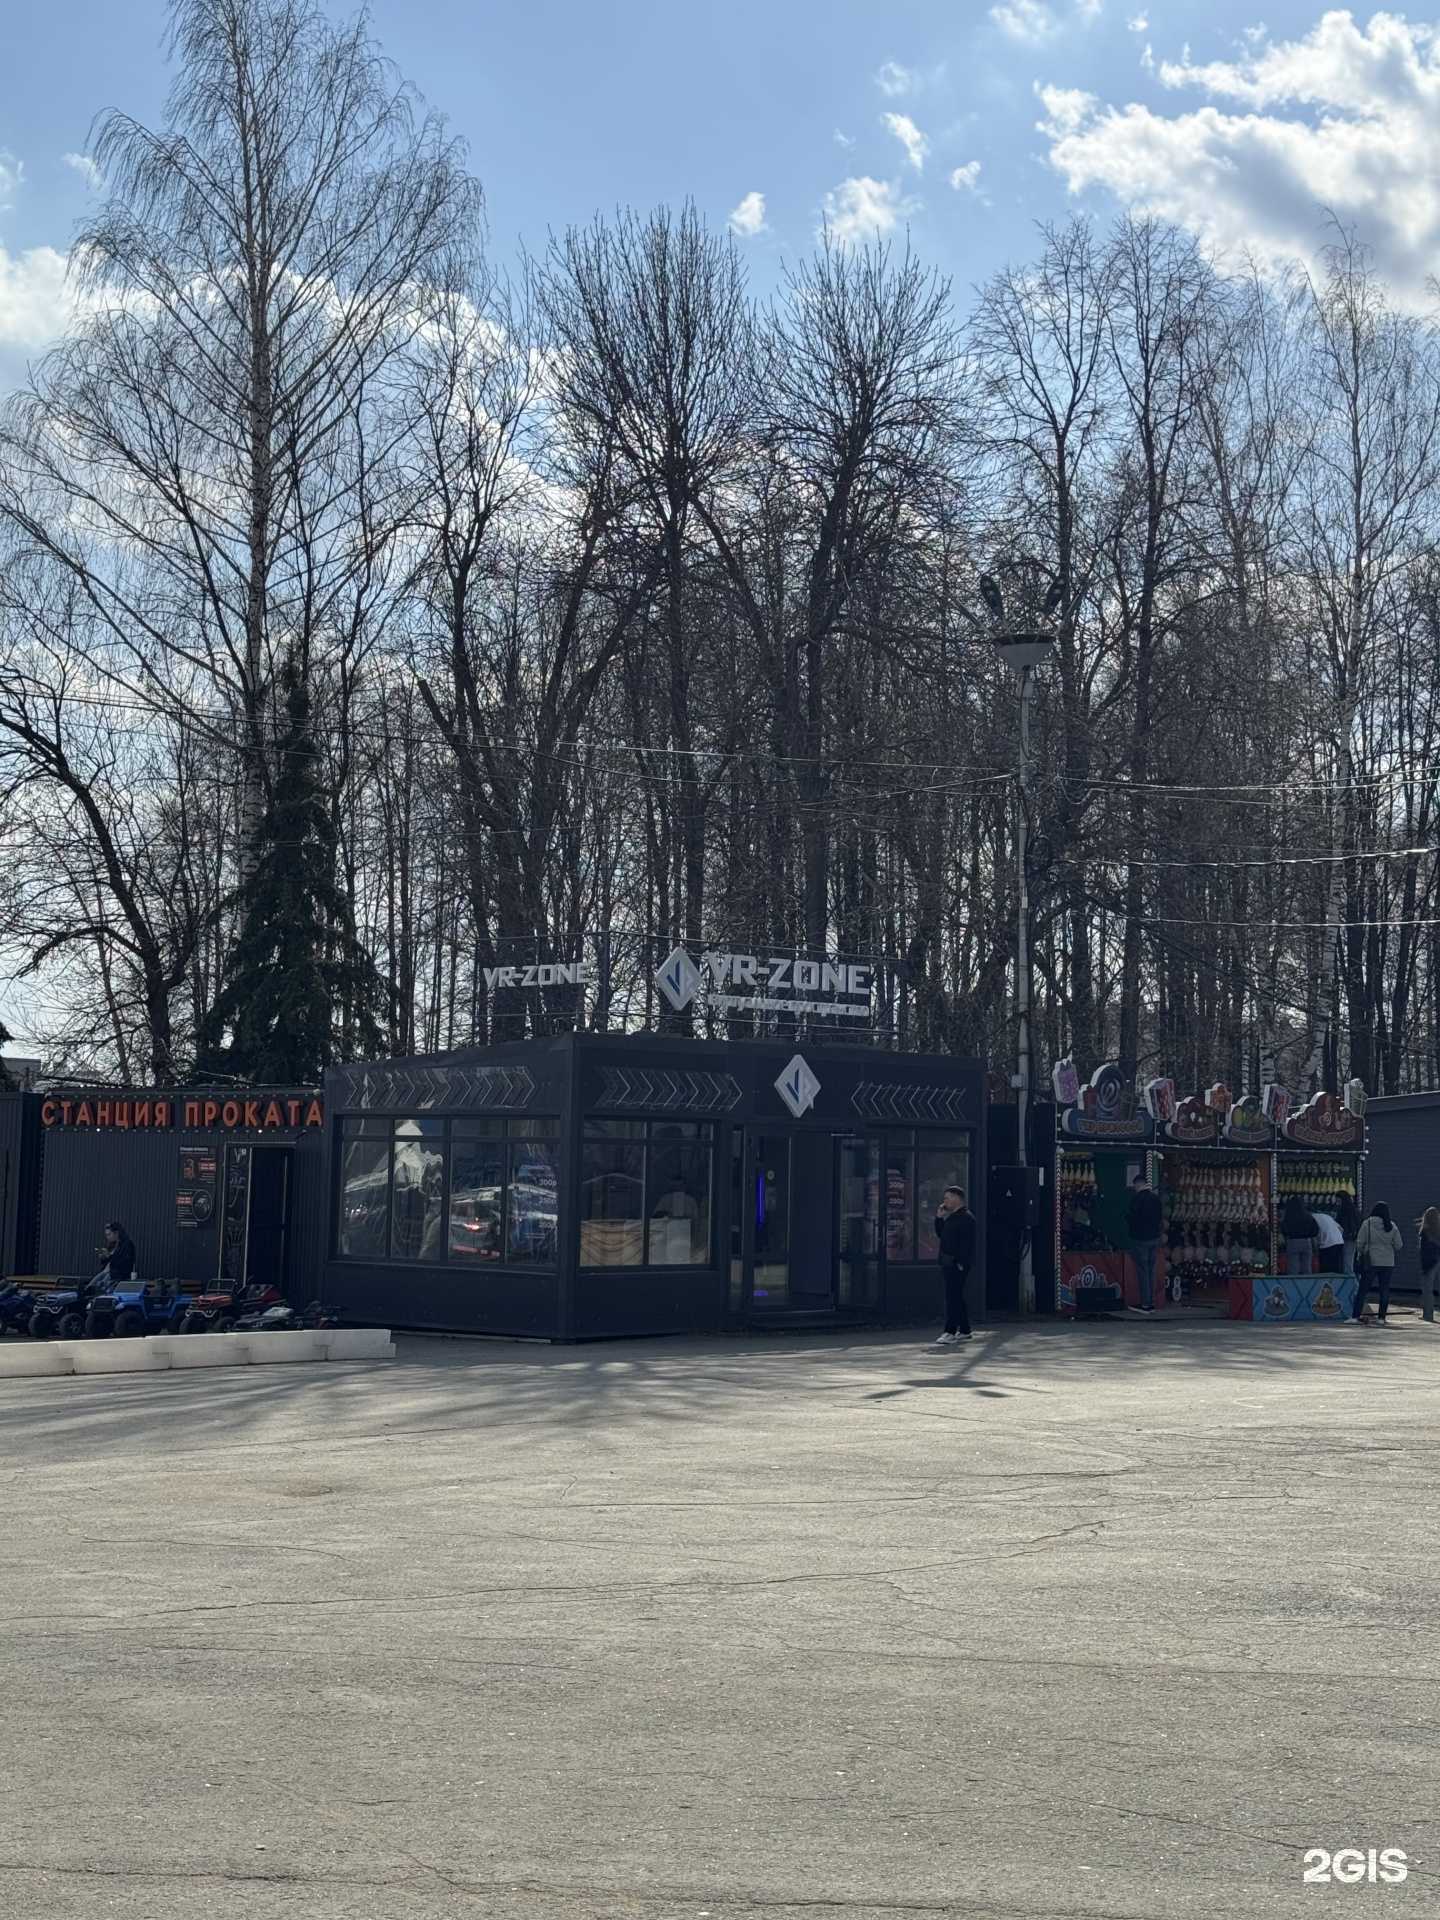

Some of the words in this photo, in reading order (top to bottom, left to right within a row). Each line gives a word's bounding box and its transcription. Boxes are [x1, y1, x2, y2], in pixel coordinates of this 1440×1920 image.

[483, 962, 593, 988] VR-ZONE
[704, 952, 869, 994] VR-ZONE
[41, 1100, 171, 1128] СТАНЦИЯ
[185, 1100, 323, 1128] ПРОКАТА
